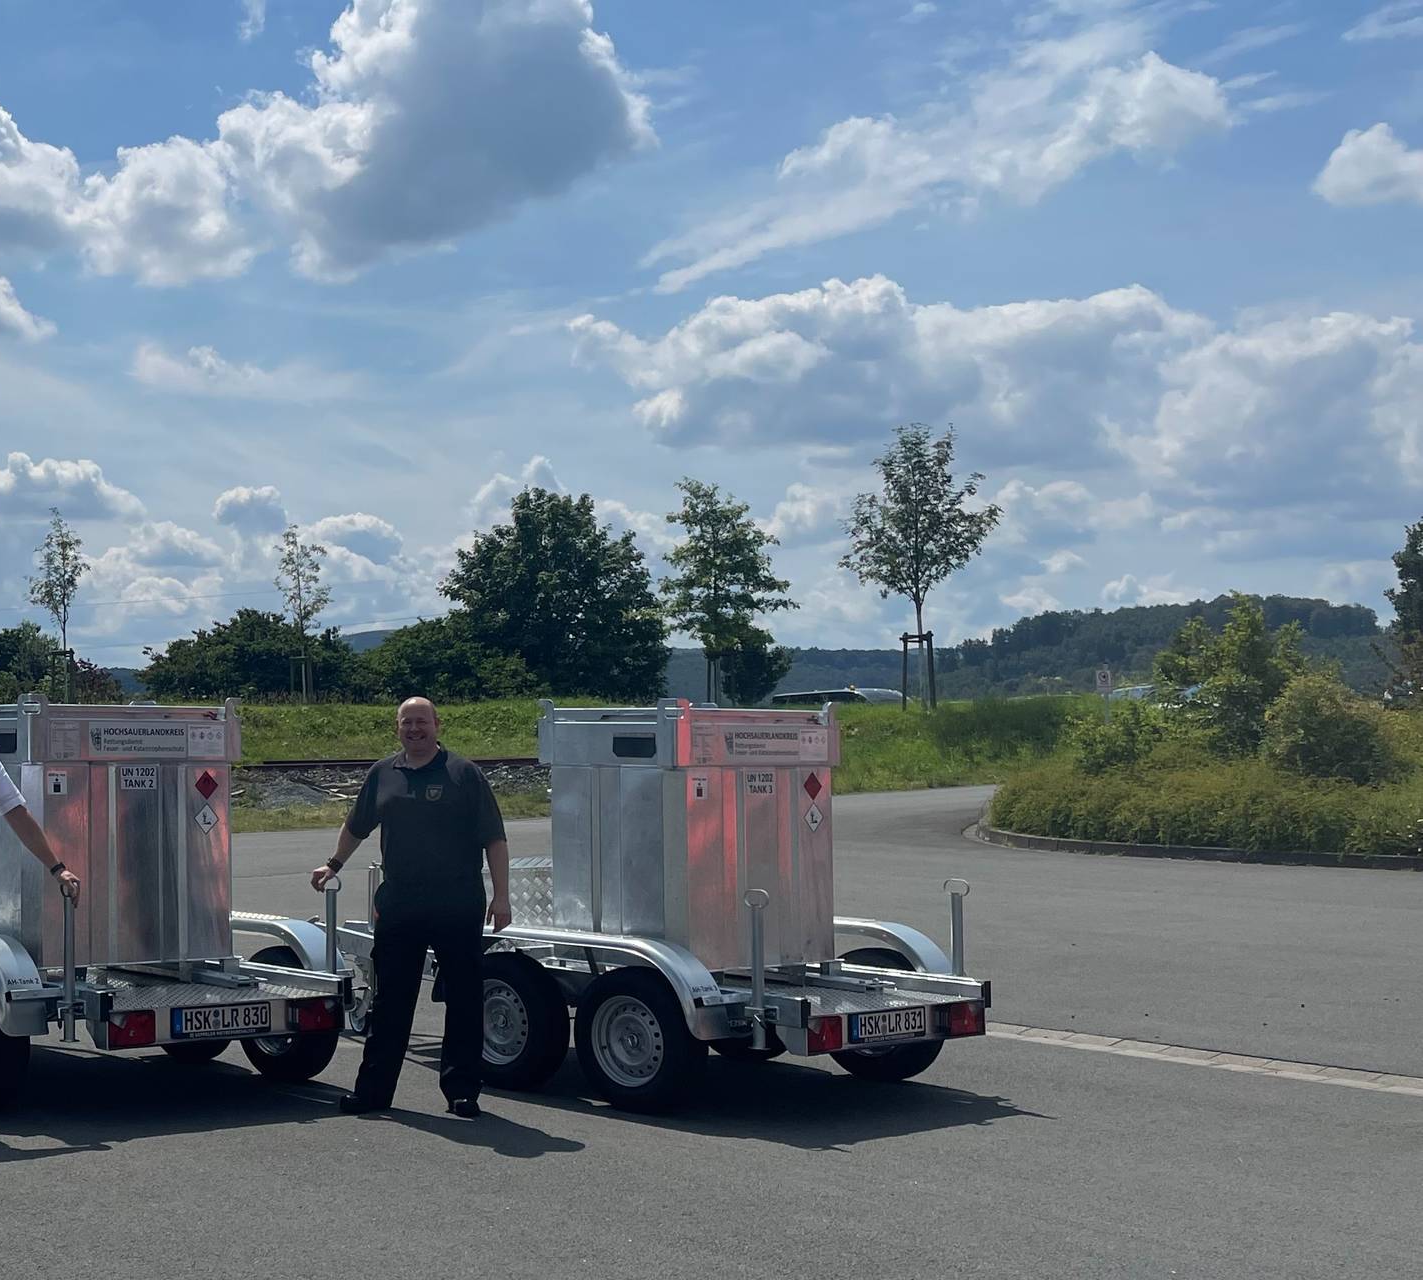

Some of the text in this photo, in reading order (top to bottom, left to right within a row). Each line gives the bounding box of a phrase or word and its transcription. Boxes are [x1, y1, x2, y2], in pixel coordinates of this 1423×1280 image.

[103, 728, 184, 736] HOCHSAUERLANDKREIS
[734, 732, 798, 740] HOCHSAUERLANDKREIS
[122, 768, 154, 776] UN 1202
[747, 773, 773, 782] UN 1202
[124, 780, 154, 788] TANK 2
[749, 785, 773, 793] TANK 3
[184, 1006, 268, 1031] HSK LR 830
[859, 1010, 923, 1036] HSK LR 831
